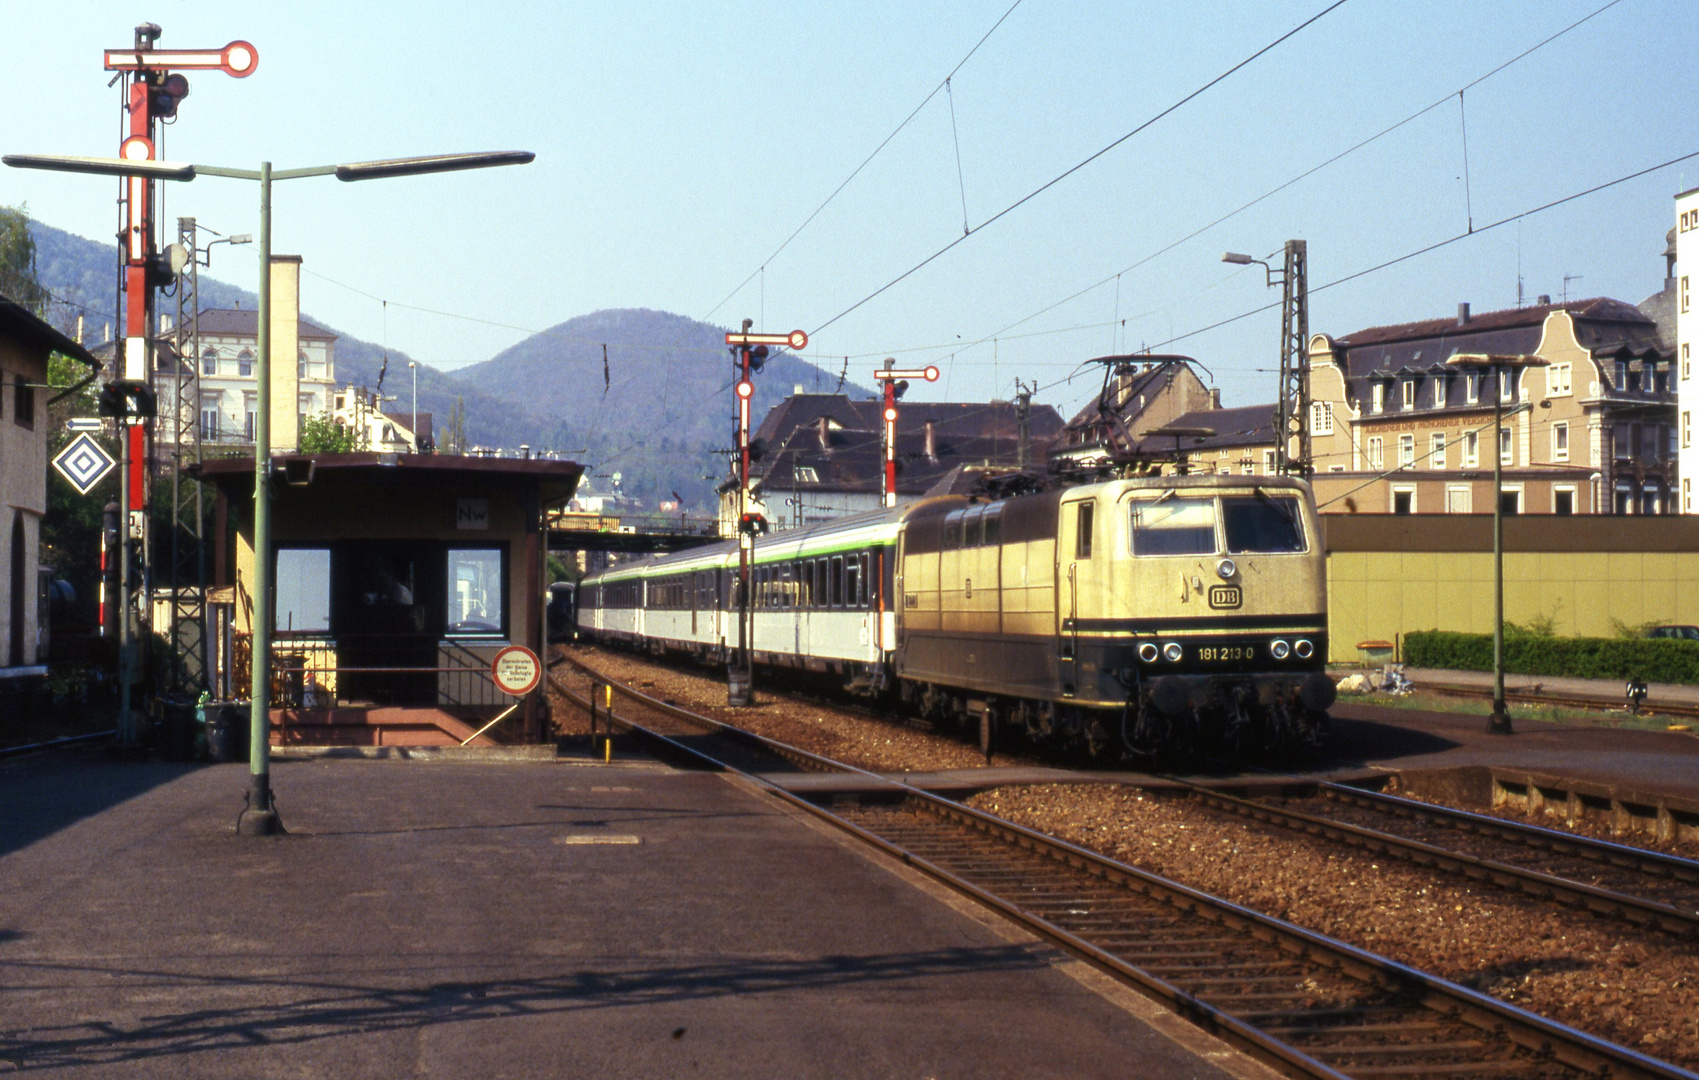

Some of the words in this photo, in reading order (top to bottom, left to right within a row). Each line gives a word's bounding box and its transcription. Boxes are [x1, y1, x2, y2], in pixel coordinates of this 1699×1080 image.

[1402, 422, 1416, 431] UND
[458, 506, 487, 521] Nw
[136, 524, 142, 535] 5
[1215, 591, 1236, 603] DB
[1199, 647, 1217, 660] 181
[1220, 647, 1254, 660] 213-0
